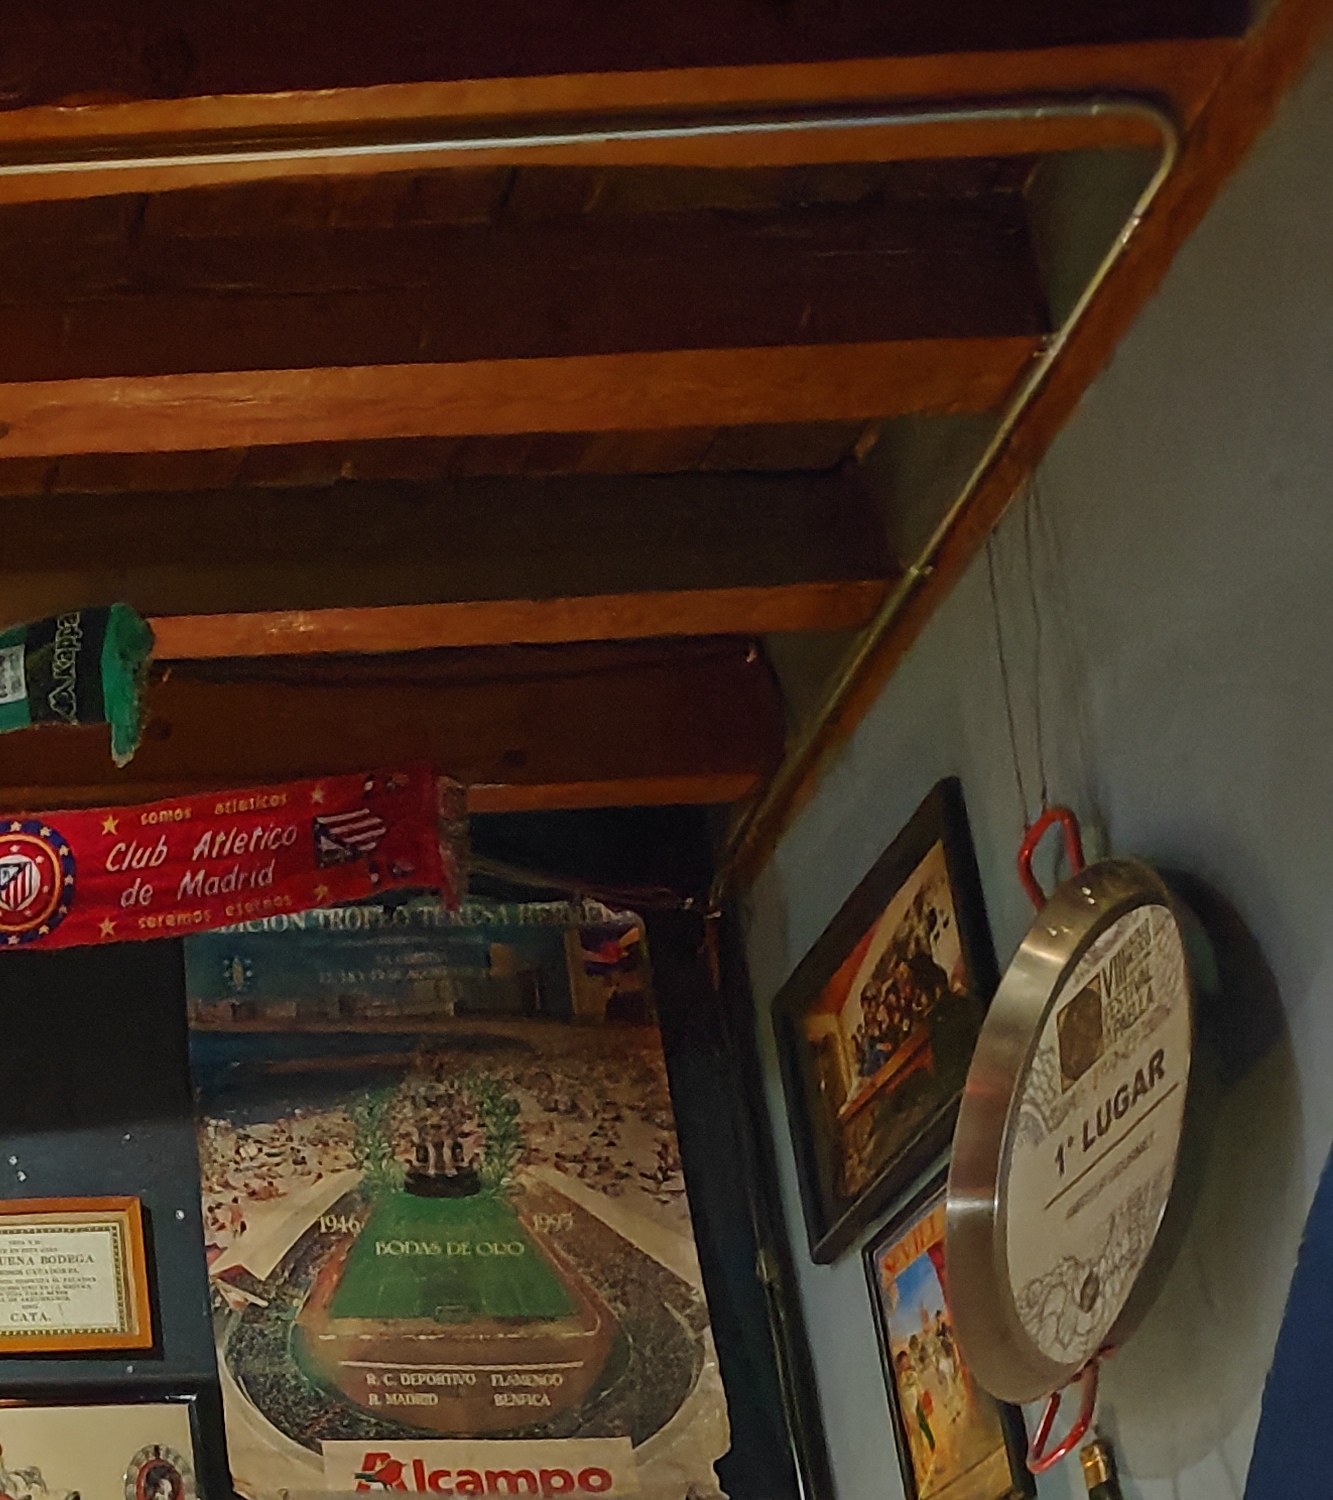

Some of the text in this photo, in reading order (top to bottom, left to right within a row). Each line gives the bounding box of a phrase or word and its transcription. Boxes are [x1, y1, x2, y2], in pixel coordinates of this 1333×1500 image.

[140, 807, 193, 826] somos
[106, 823, 299, 873] Club Atletico
[120, 859, 276, 909] de Madrid
[1082, 1047, 1167, 1154] LUGAR
[317, 1216, 365, 1236] 1946
[446, 1240, 472, 1257] DE
[476, 1240, 526, 1257] ORO
[355, 1452, 614, 1498] Alcampo
